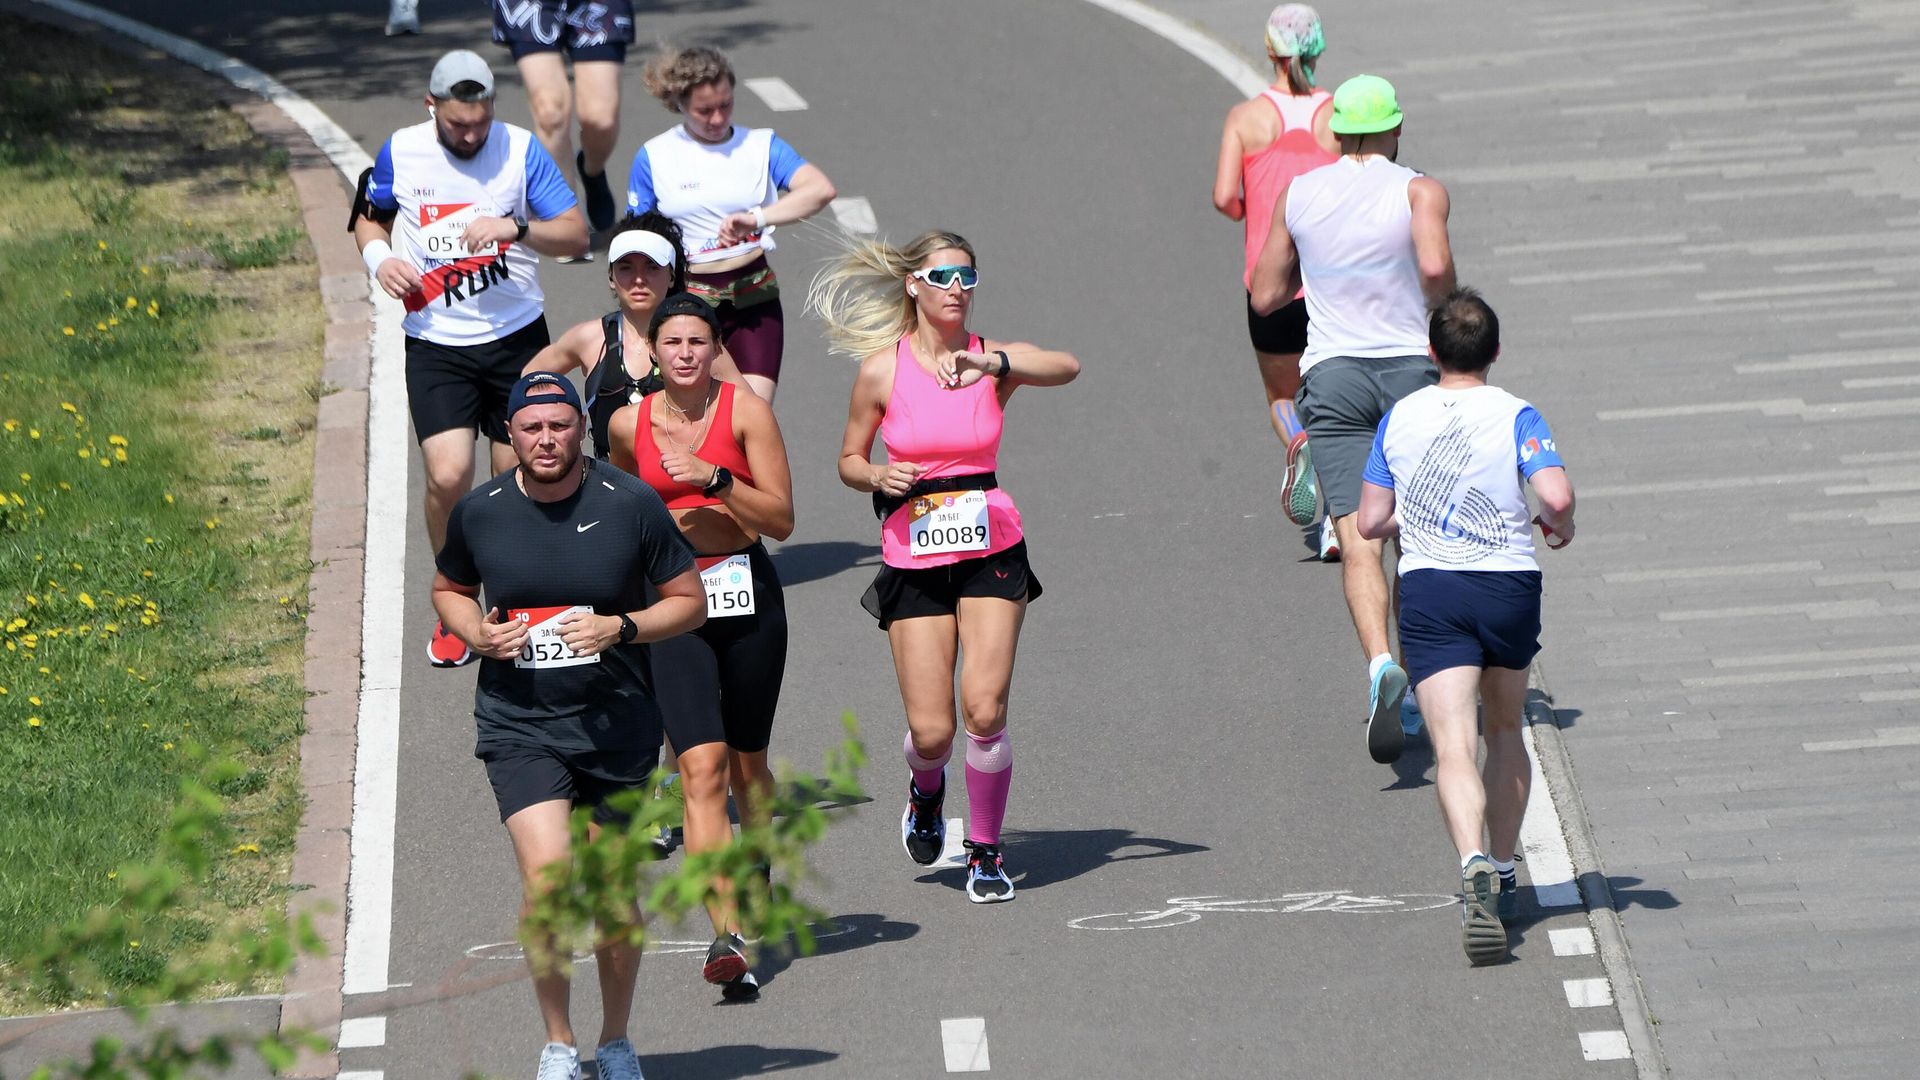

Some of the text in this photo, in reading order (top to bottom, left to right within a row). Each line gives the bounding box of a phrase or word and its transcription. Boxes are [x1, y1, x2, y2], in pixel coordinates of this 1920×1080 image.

[426, 206, 439, 217] 10
[444, 251, 509, 308] RUN
[917, 525, 987, 547] 00089
[708, 590, 750, 610] 150
[515, 612, 530, 622] 10
